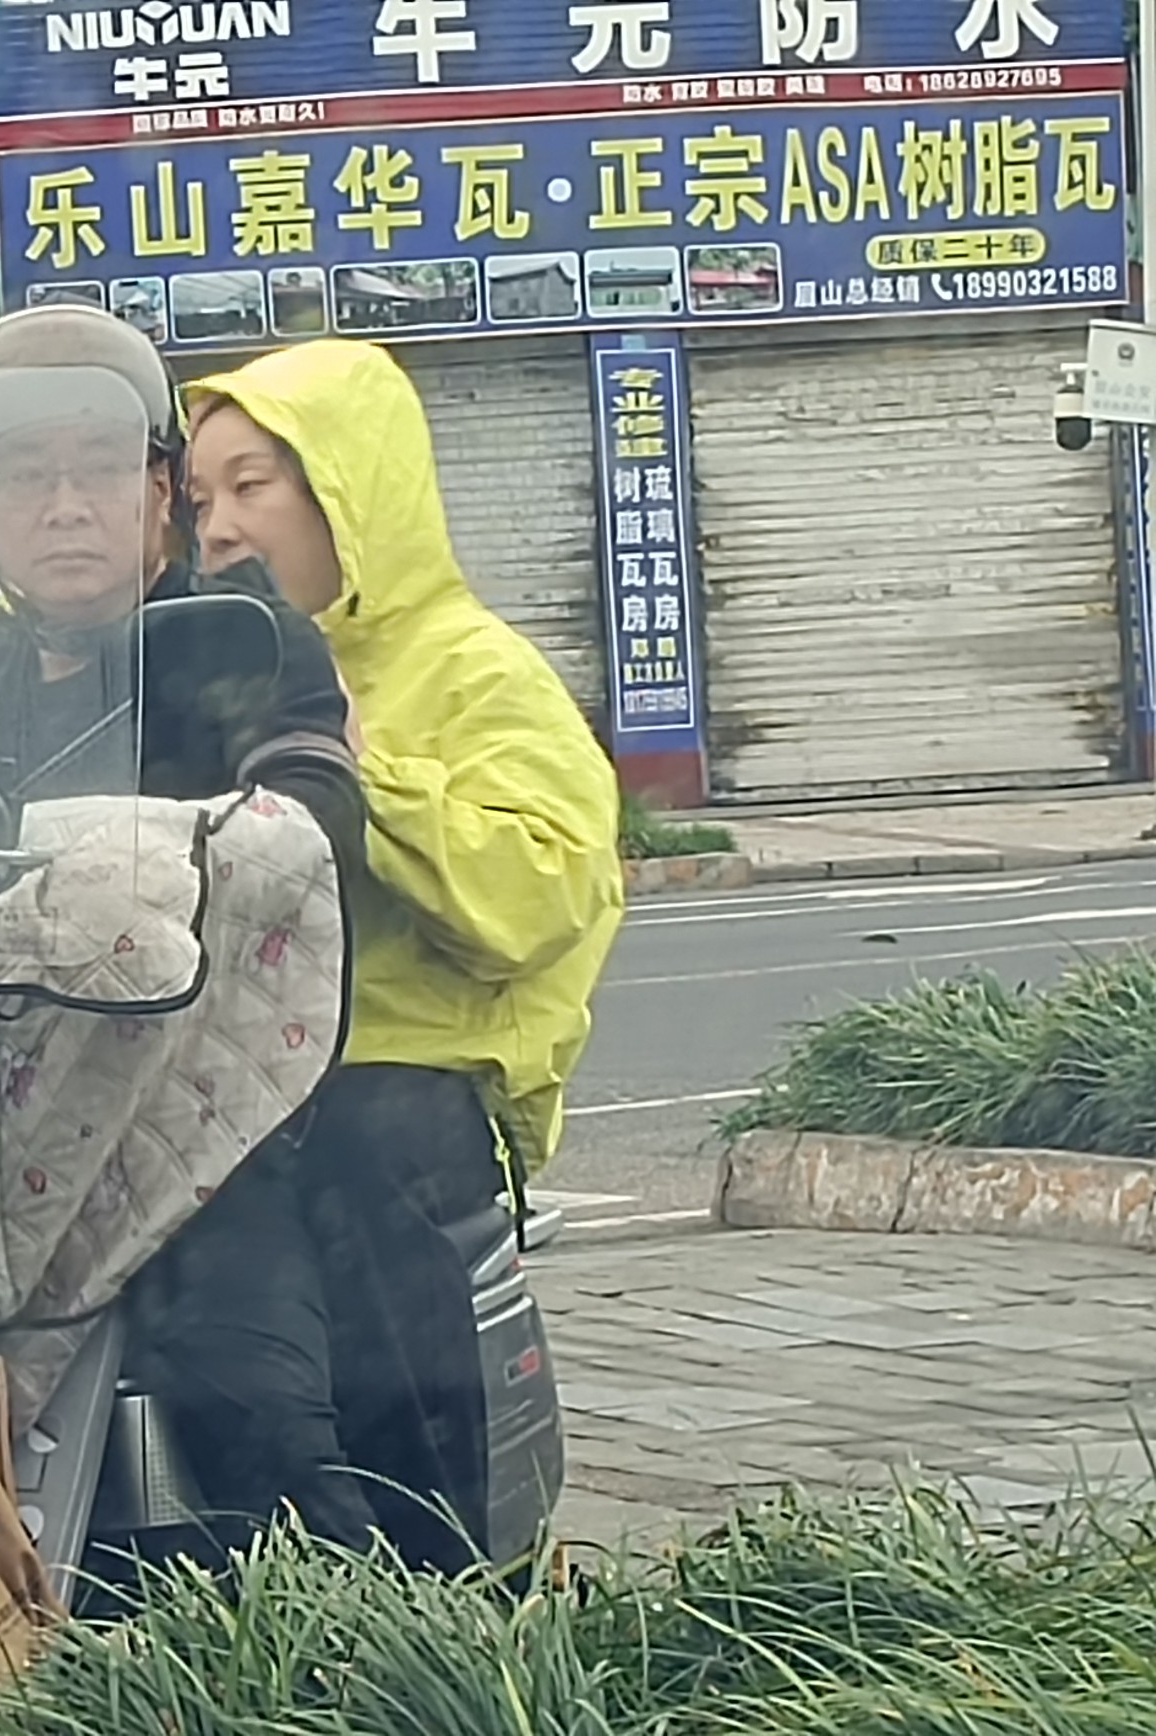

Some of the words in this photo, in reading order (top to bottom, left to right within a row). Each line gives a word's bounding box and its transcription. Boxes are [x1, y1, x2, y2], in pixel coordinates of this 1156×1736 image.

[114, 52, 230, 100] 牛元
[878, 234, 1035, 265] 质保二十年
[951, 265, 1118, 300] 18990321588
